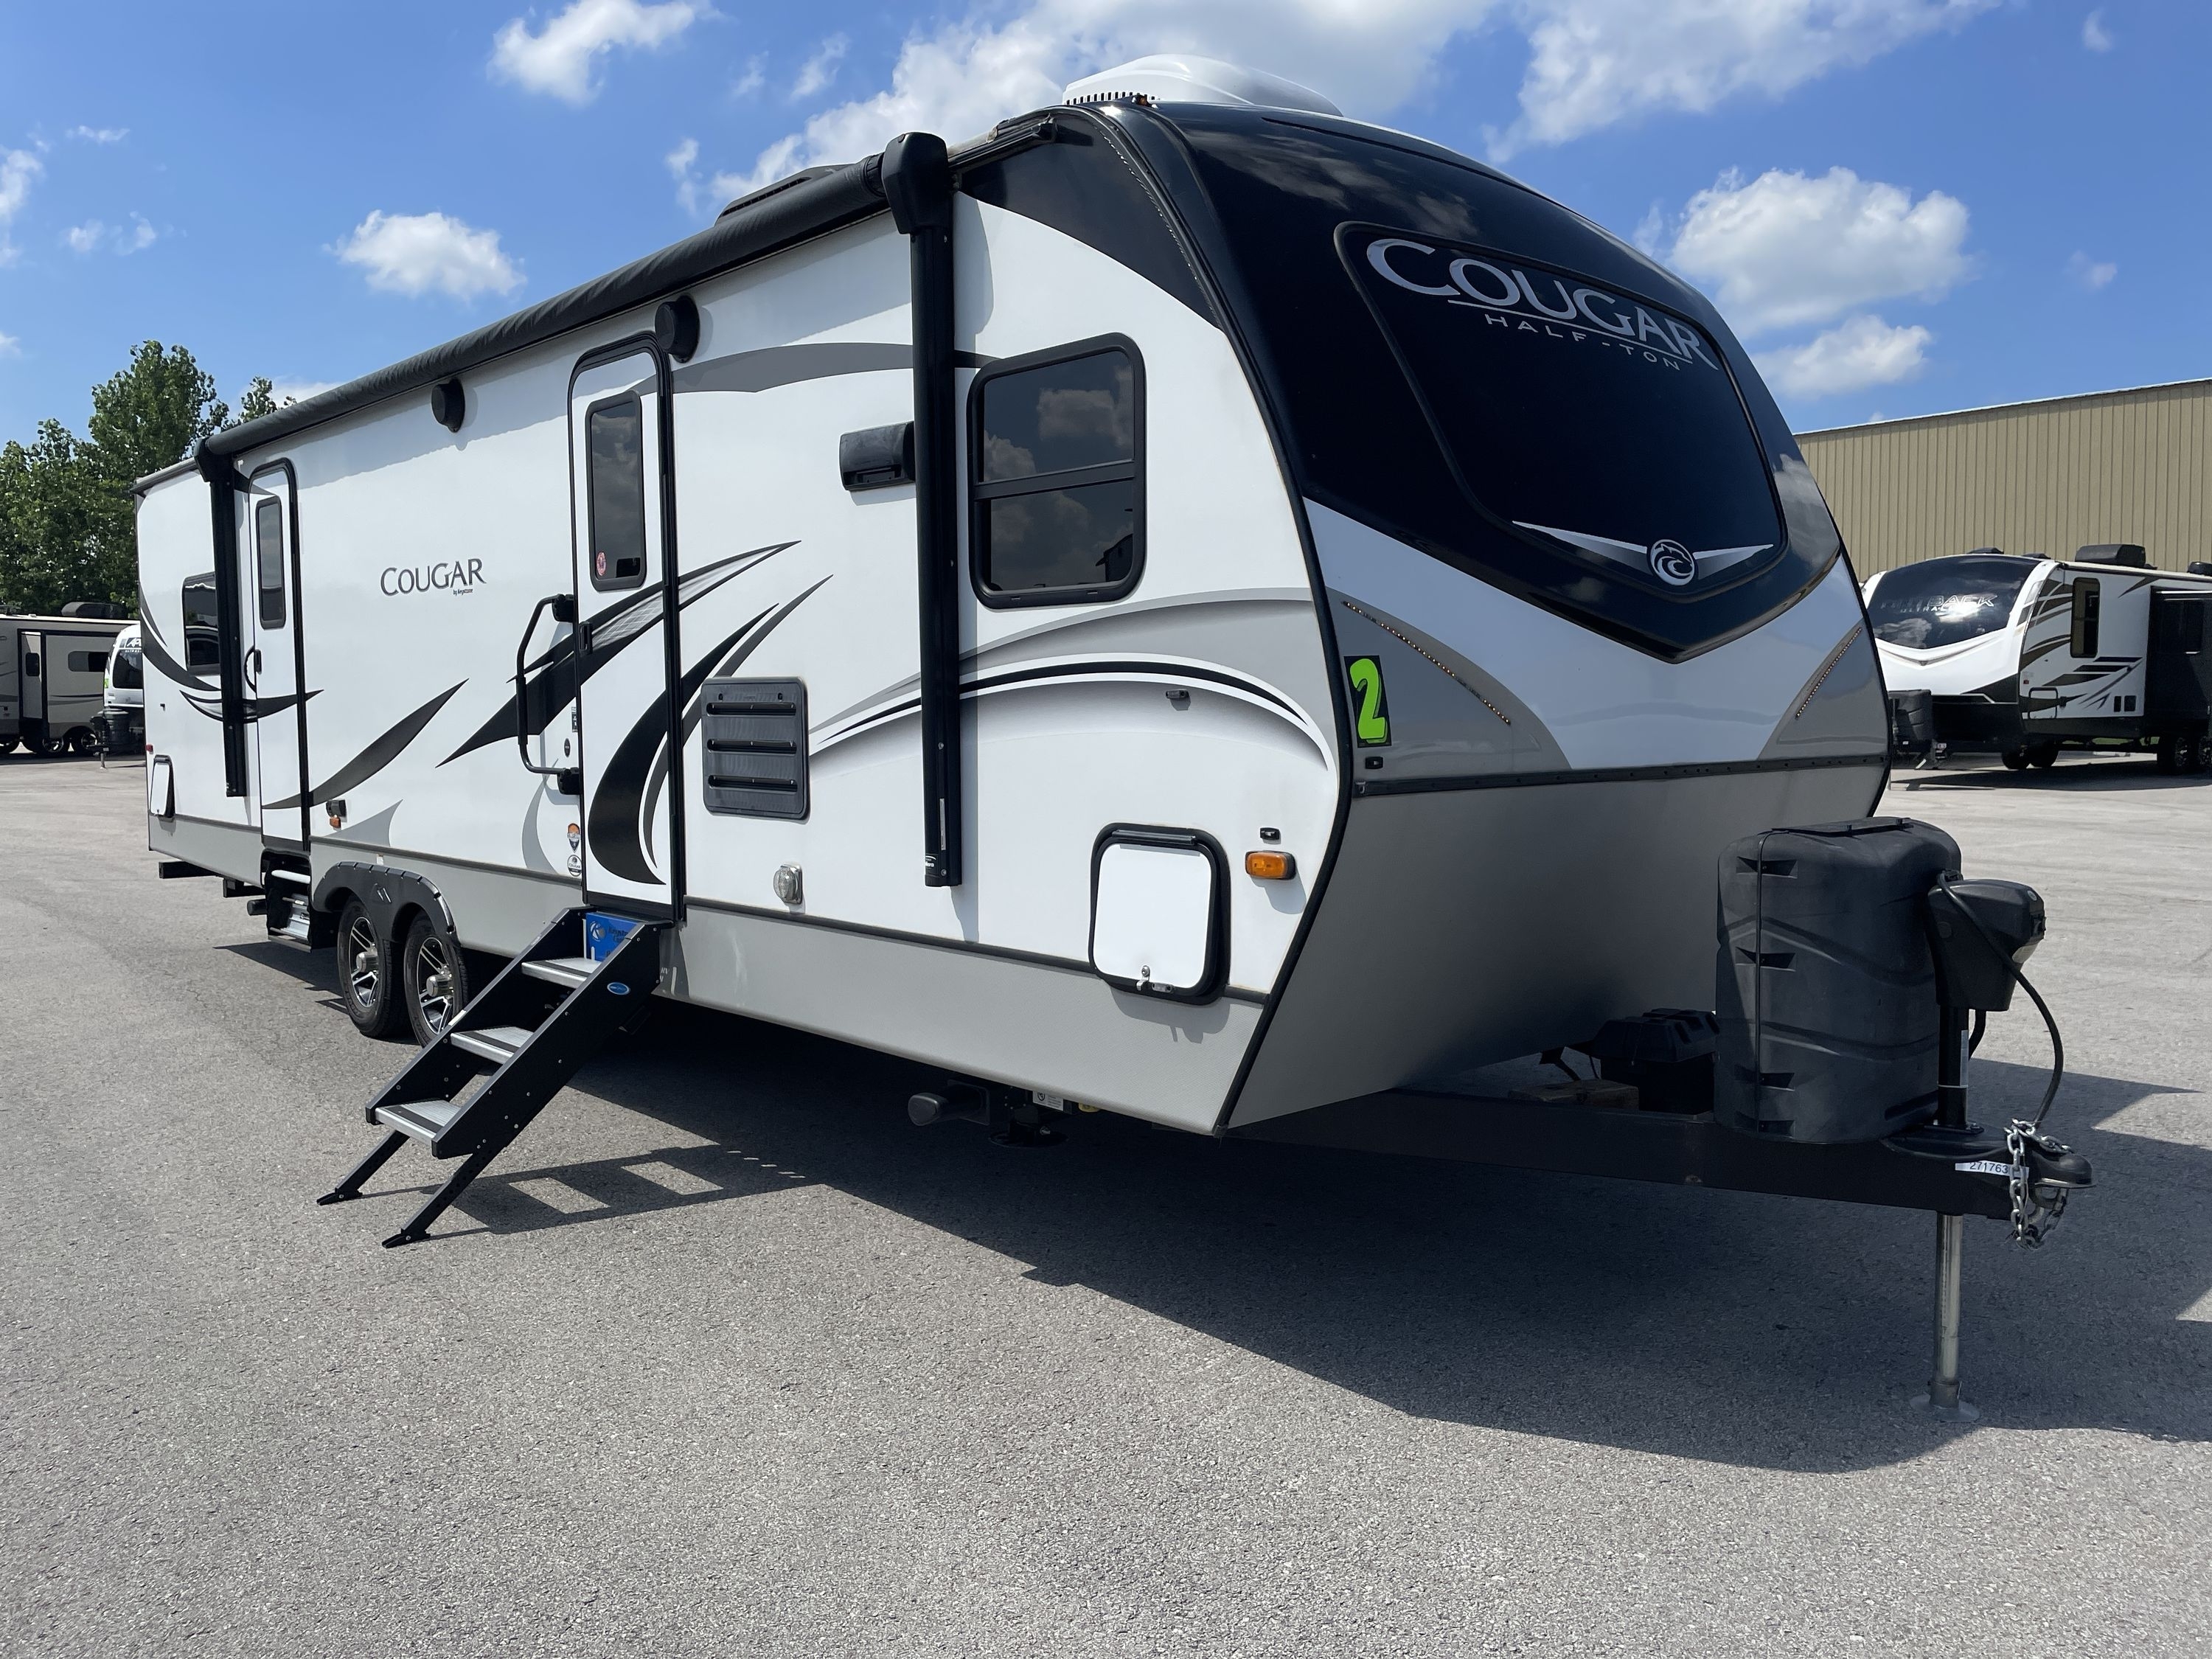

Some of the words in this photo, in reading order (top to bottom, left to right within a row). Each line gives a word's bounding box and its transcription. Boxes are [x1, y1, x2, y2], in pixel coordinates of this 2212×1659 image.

[1366, 238, 1719, 370] COUGAR
[380, 557, 487, 597] COUGAR
[1349, 658, 1388, 745] 2
[1969, 1161, 2009, 1174] 271763
